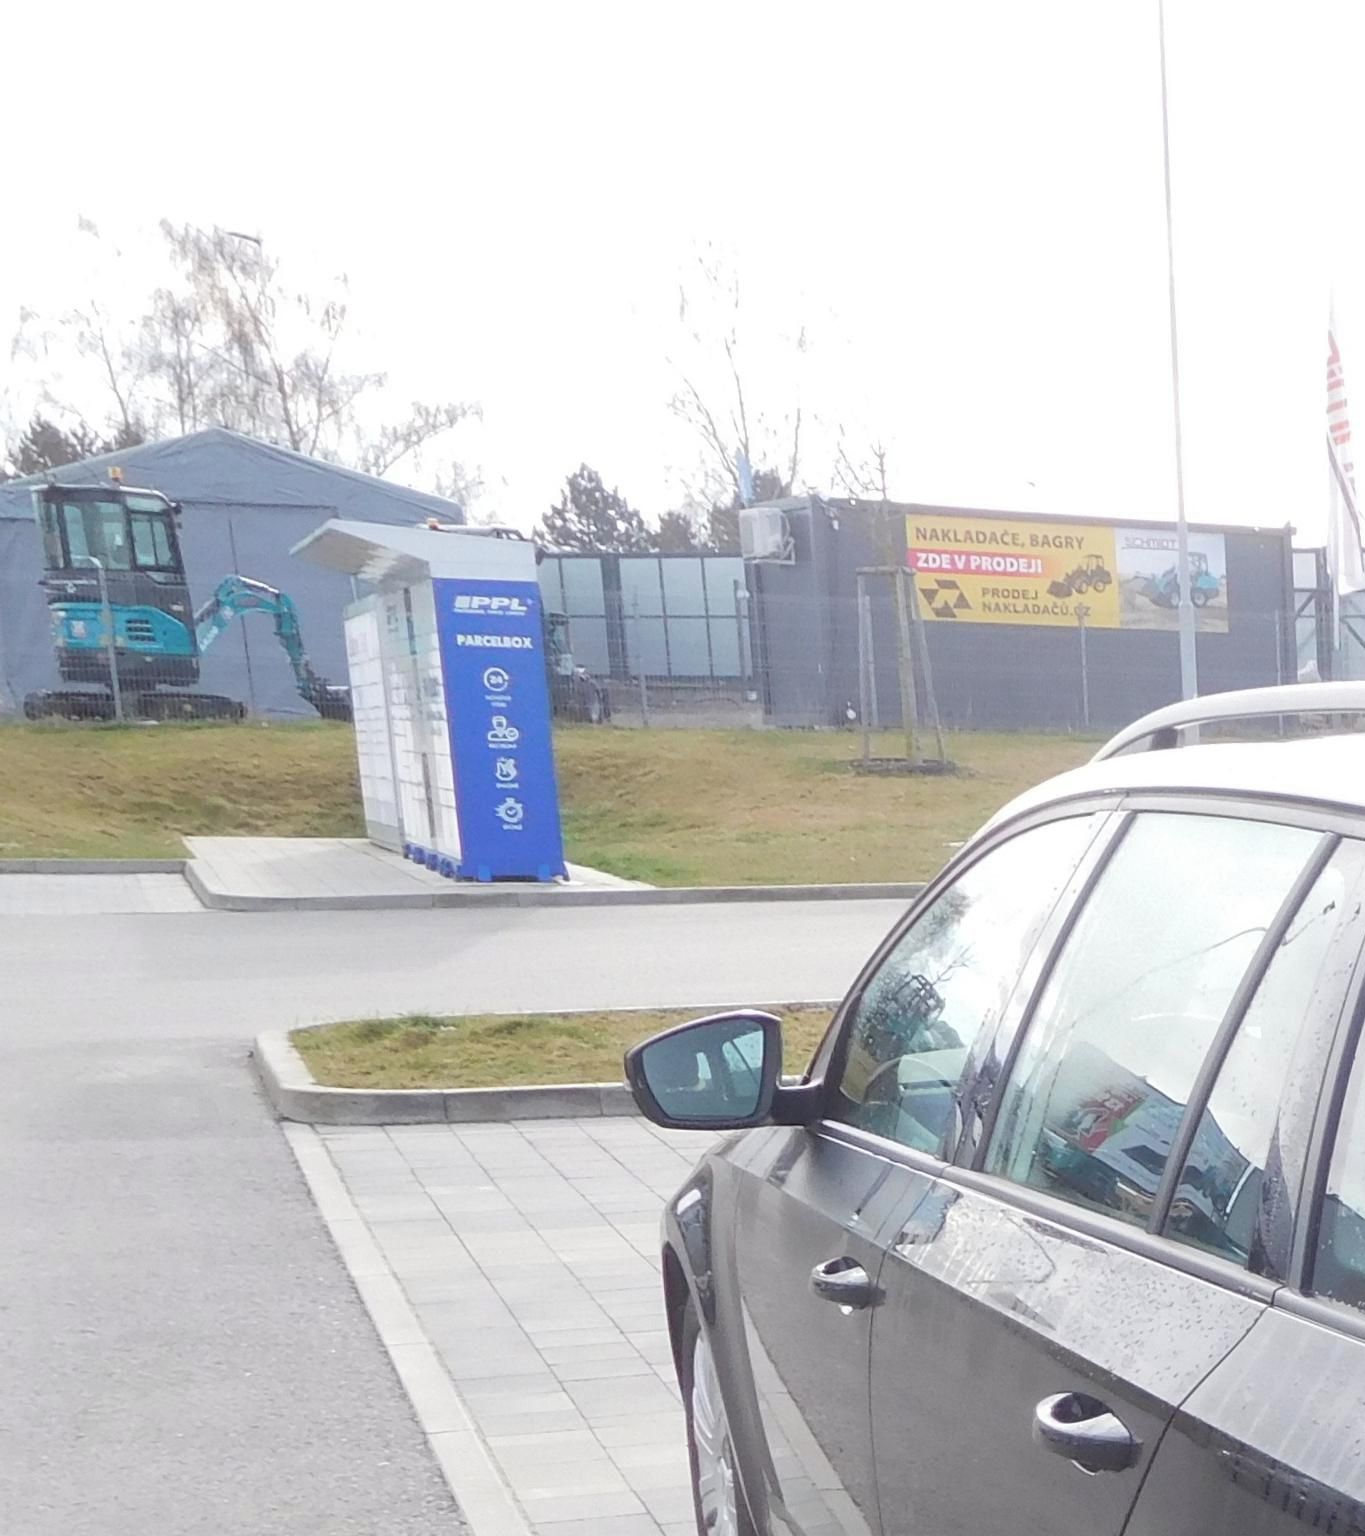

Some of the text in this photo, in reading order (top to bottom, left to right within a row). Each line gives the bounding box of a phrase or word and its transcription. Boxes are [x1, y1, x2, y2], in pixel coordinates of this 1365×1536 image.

[915, 527, 1085, 550] NAKLADAČE, BAGRY
[916, 553, 1042, 573] ZDE V PRODEJI
[981, 587, 1039, 600] PRODEJ
[471, 596, 528, 611] PPL
[456, 634, 533, 649] PARCELBOX
